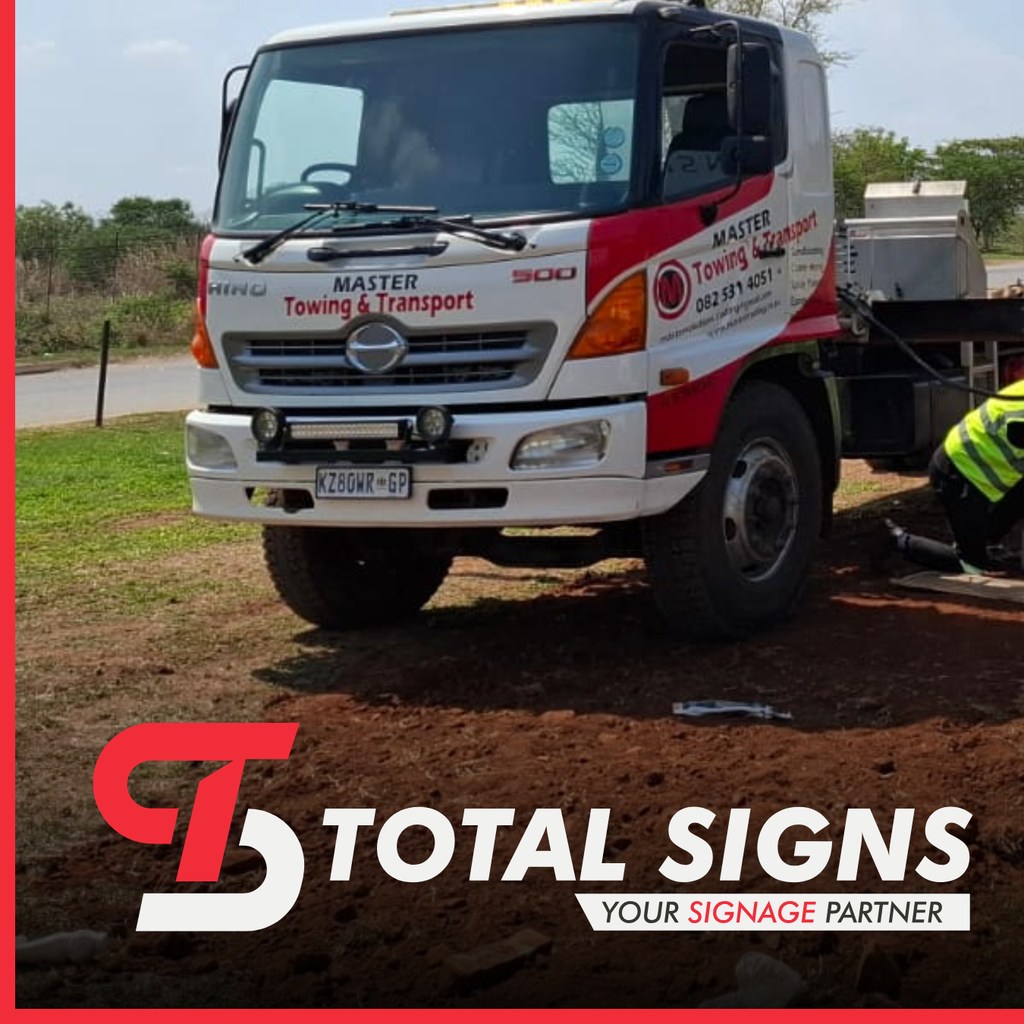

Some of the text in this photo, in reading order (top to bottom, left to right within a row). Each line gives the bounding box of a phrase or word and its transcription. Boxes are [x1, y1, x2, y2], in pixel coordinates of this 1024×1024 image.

[712, 209, 771, 250] MASTER
[692, 245, 749, 285] Towing
[761, 209, 818, 251] Transport
[333, 274, 419, 293] MASTER
[511, 267, 577, 283] 500
[284, 290, 475, 320] Towing & Transport
[696, 291, 719, 313] 082
[722, 281, 742, 302] 531
[747, 268, 773, 290] 4051
[388, 472, 407, 493] GP
